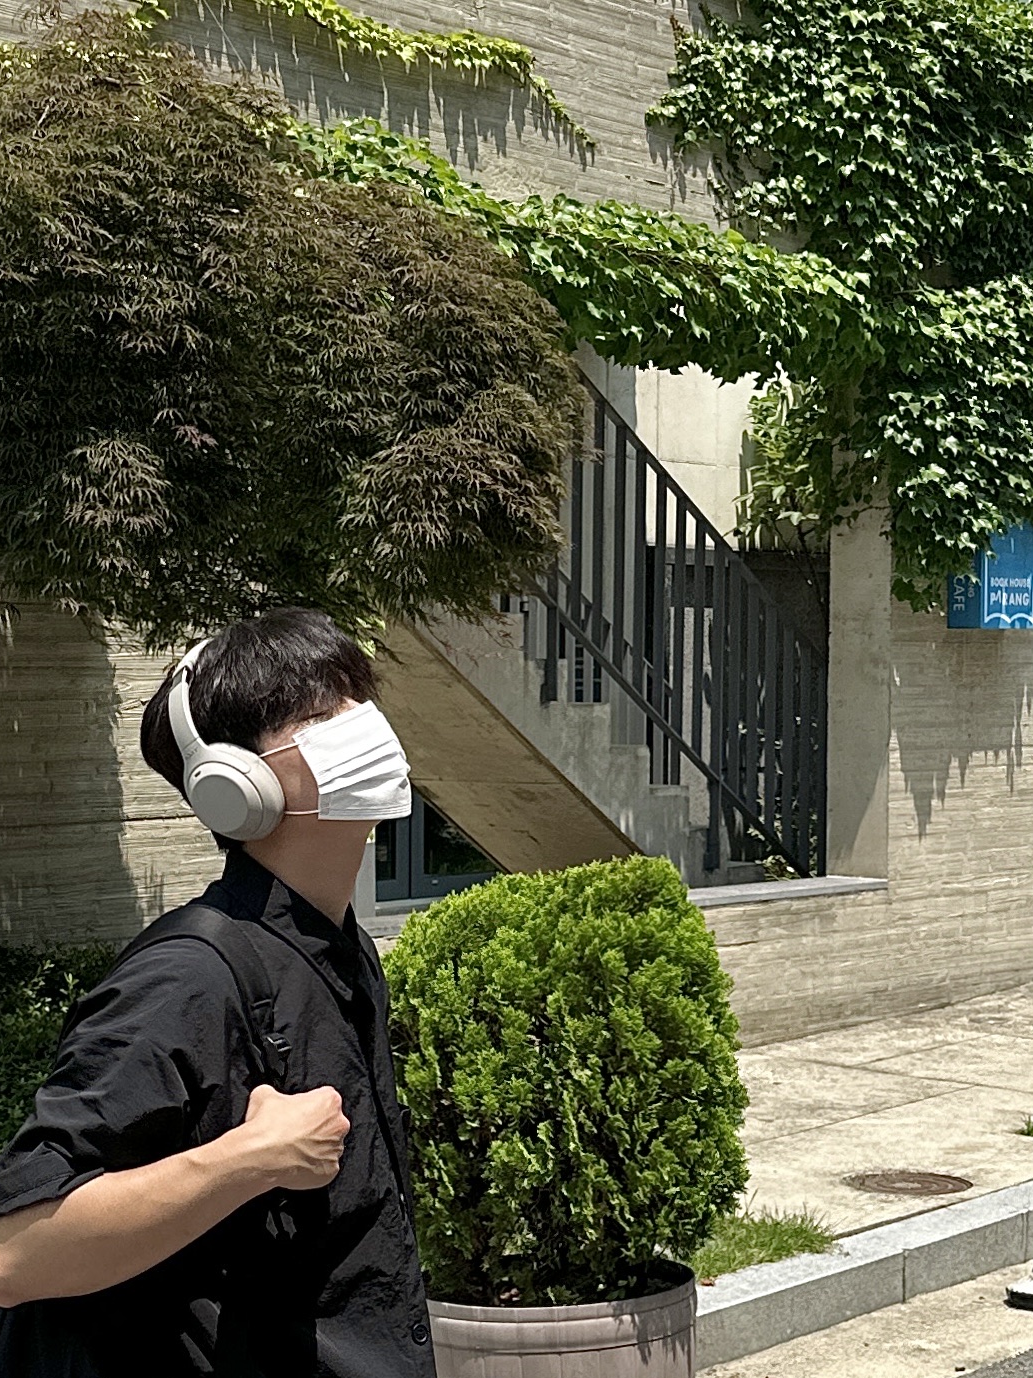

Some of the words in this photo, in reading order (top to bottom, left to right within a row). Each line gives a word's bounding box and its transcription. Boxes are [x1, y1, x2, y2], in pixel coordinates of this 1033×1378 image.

[990, 577, 1008, 587] BOOK
[1010, 578, 1031, 588] HOUSE
[953, 576, 965, 611] CAFE
[990, 590, 1029, 606] PARANG
